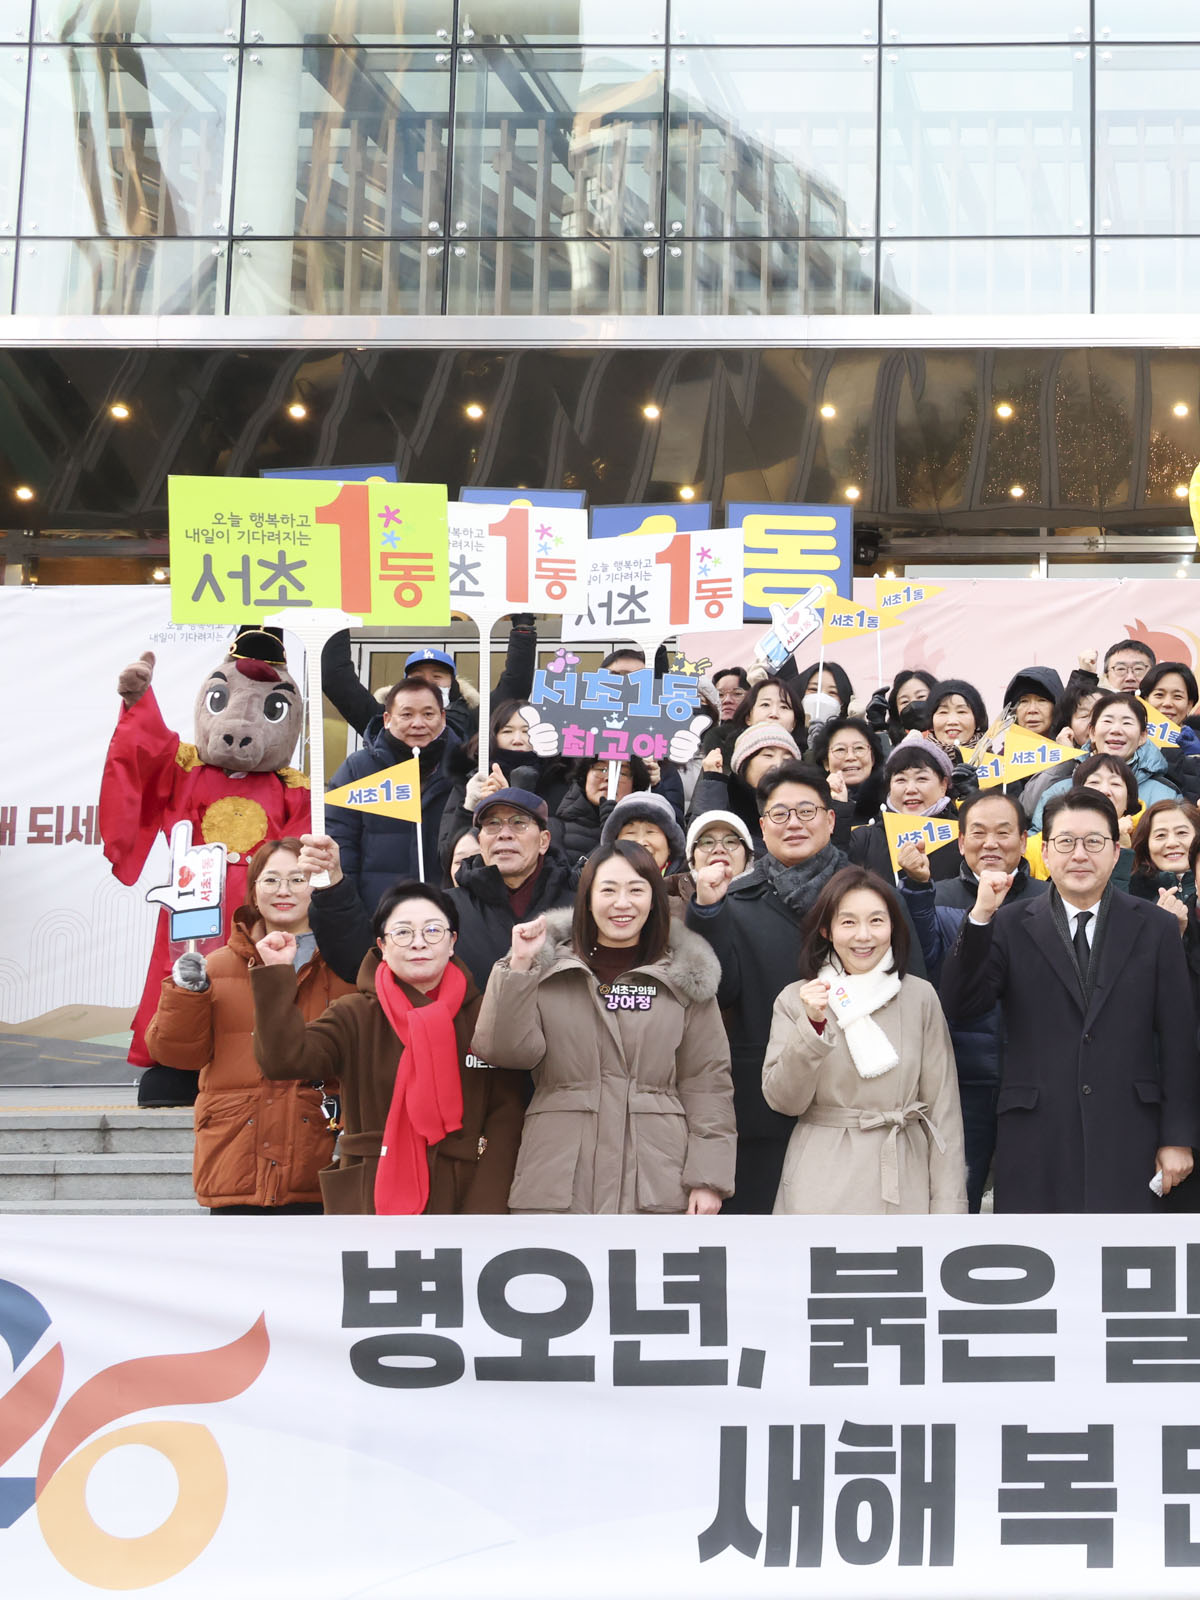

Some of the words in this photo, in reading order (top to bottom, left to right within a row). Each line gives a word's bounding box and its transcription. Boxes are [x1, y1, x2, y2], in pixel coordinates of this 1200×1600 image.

[211, 512, 243, 527] 오늘
[250, 512, 312, 528] 행복하고
[185, 528, 230, 544] 내일이
[237, 530, 312, 546] 기다려지는
[448, 527, 485, 539] 복하고
[591, 562, 609, 573] 오늘
[613, 558, 653, 571] 행복하고
[742, 514, 841, 609] 동
[604, 570, 653, 583] 기다려지는
[881, 586, 924, 607] 서초1동
[830, 610, 879, 629] 서초1동
[149, 632, 176, 643] 내일이
[180, 631, 224, 642] 기다려지는
[531, 668, 701, 721] 서초1동
[561, 724, 668, 761] 최고야
[1011, 745, 1060, 764] 서초1동
[347, 779, 411, 804] 서초1동
[610, 984, 656, 996] 서초구의원
[605, 994, 651, 1010] 강여정
[342, 1247, 766, 1388] 병오년,
[808, 1244, 1058, 1386] 붉은
[698, 1420, 956, 1567] 새해
[998, 1424, 1118, 1568] 복
